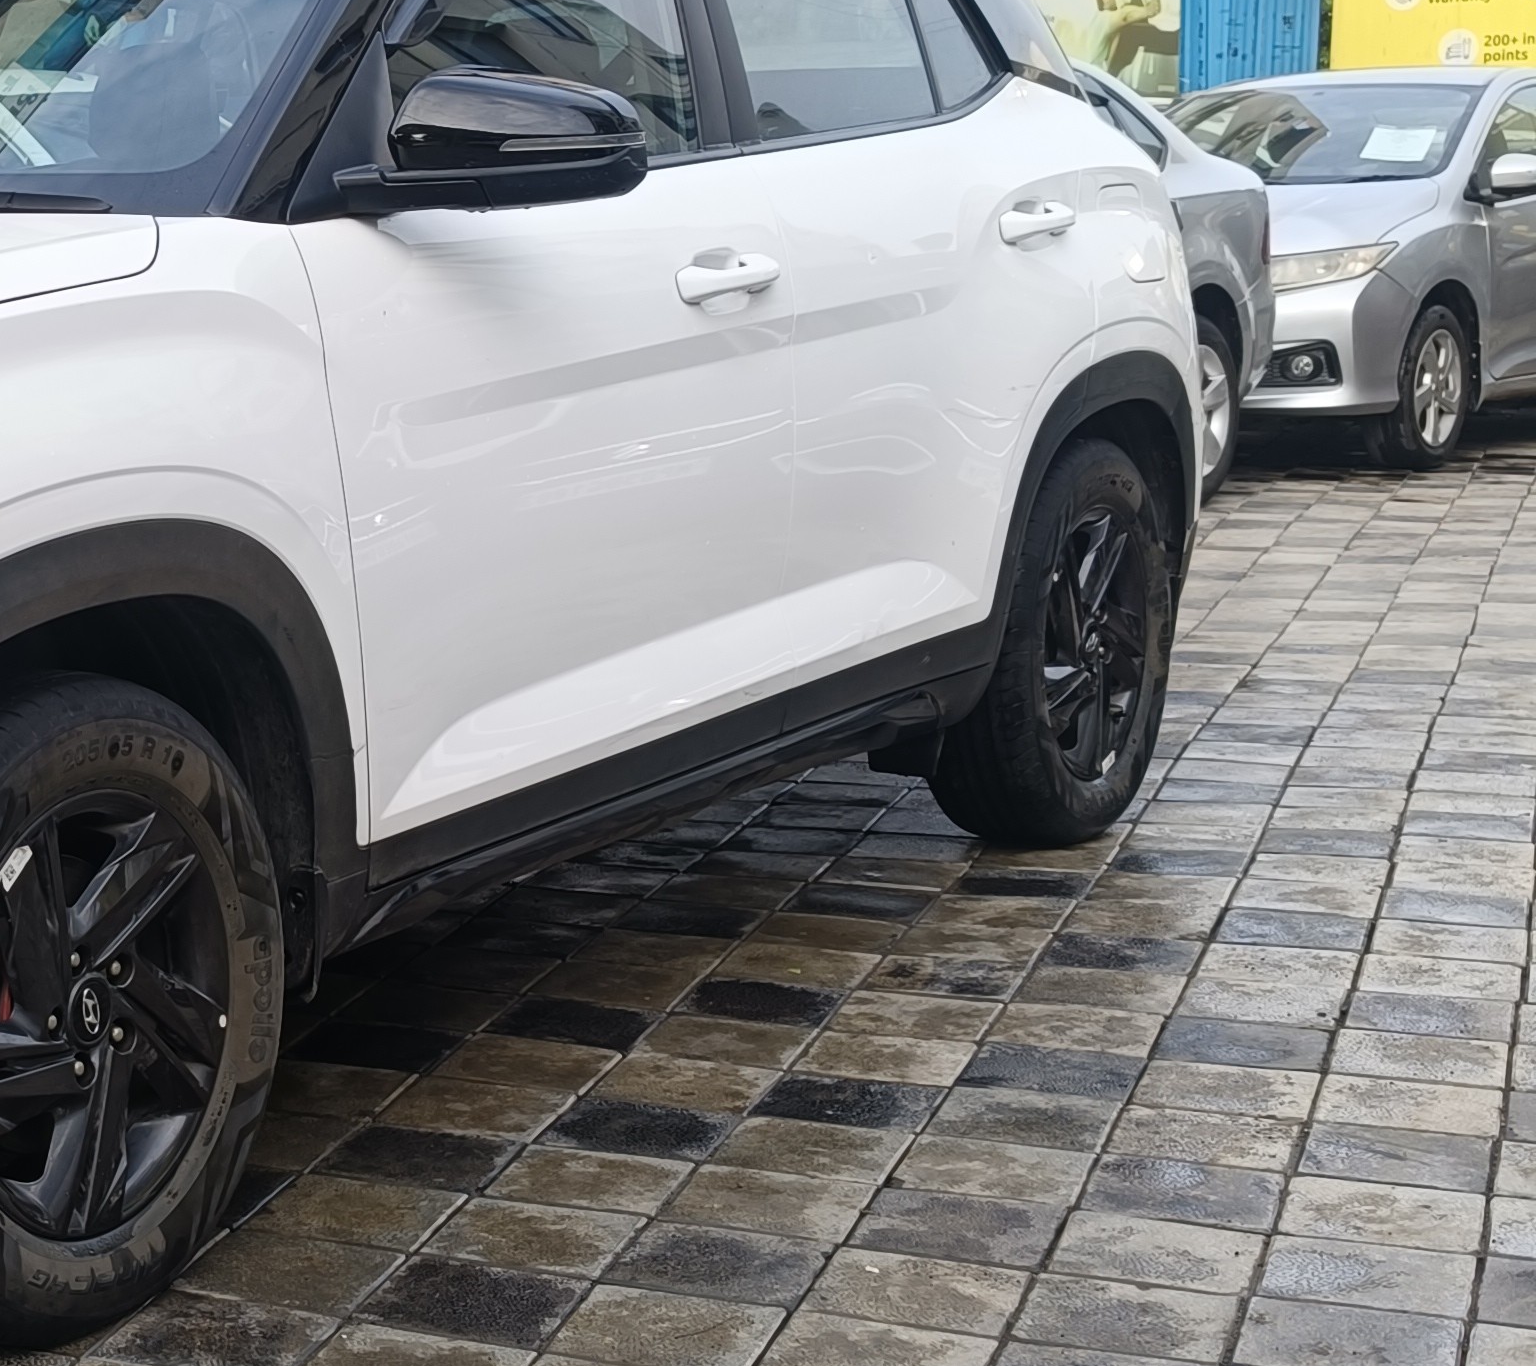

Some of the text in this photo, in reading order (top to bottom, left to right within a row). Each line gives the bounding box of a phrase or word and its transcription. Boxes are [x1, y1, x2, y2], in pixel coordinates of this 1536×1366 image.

[1484, 34, 1518, 47] 200+
[1483, 49, 1528, 63] points
[140, 736, 156, 759] R
[244, 935, 276, 1063] apollo
